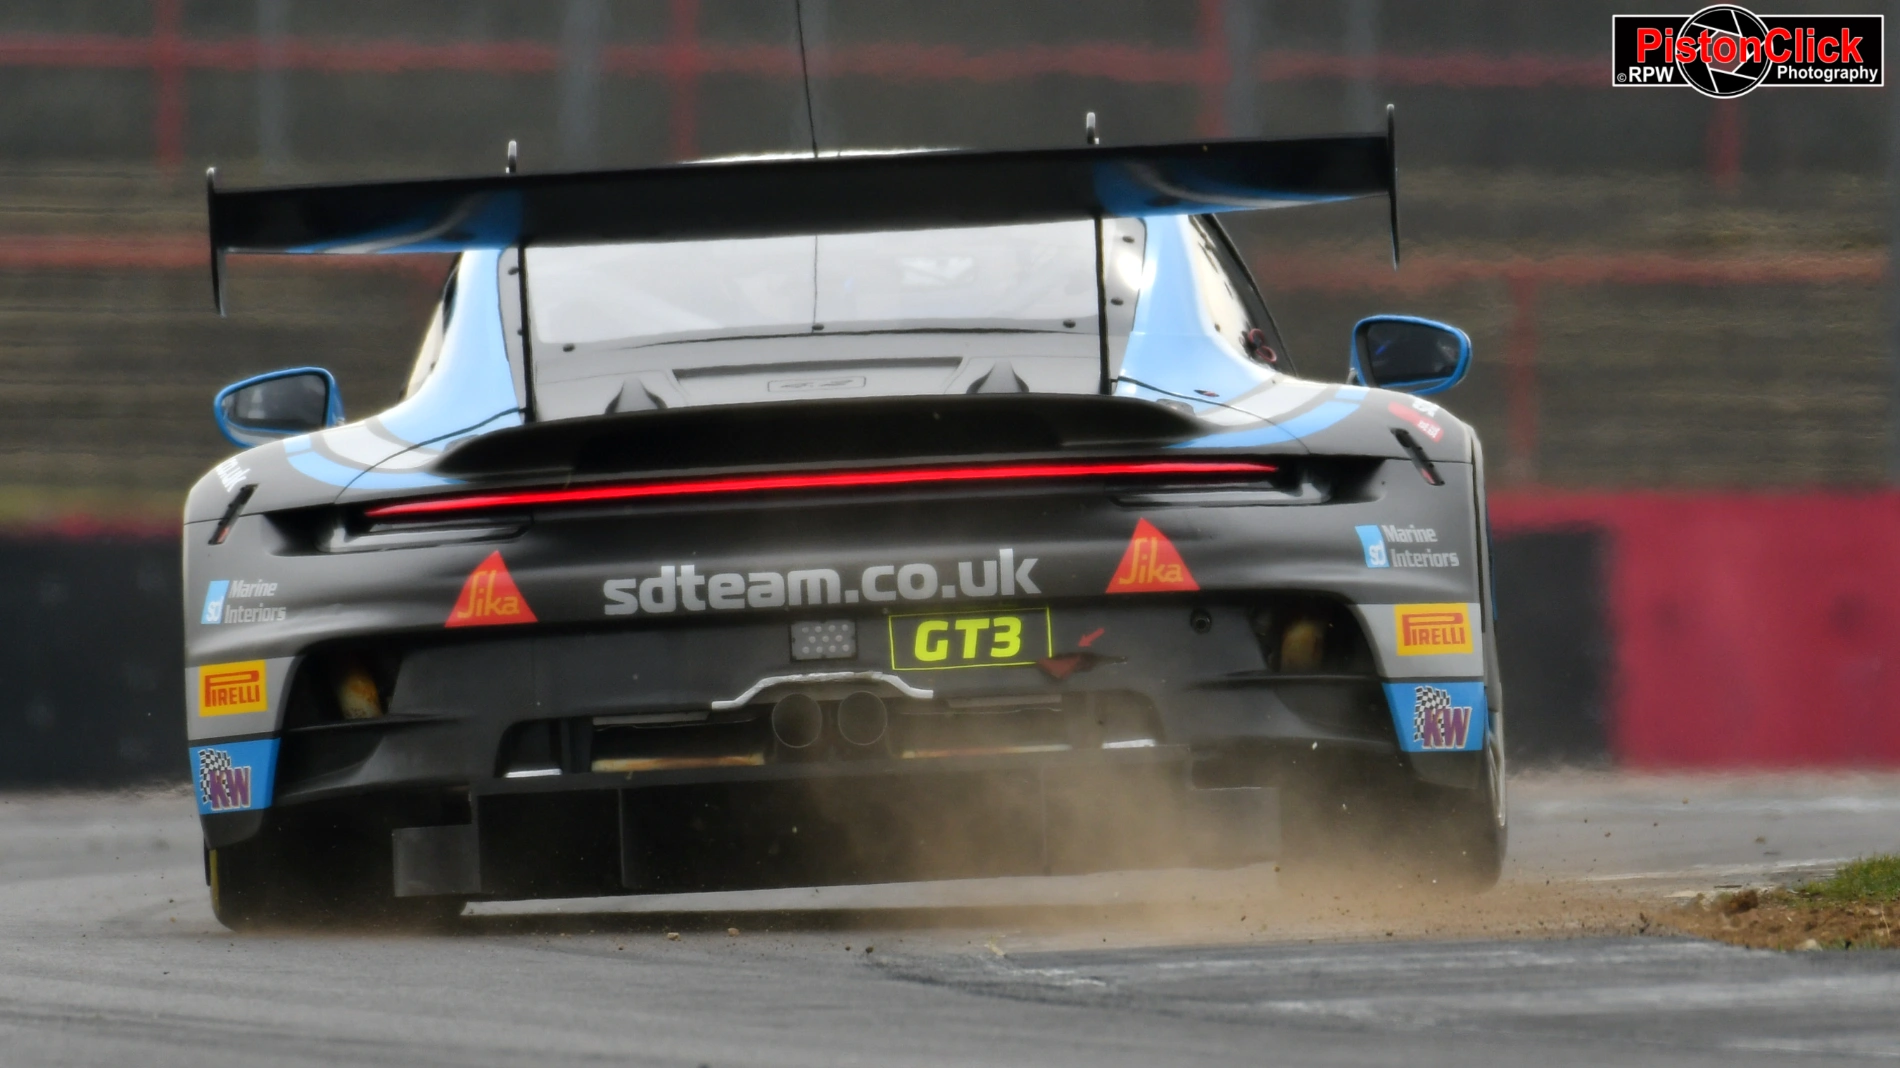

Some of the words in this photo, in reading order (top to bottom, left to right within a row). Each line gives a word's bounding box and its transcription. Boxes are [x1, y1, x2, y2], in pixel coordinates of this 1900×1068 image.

[1382, 524, 1438, 543] Marine
[1119, 536, 1184, 585] Sika
[1390, 548, 1460, 568] Interiors
[228, 579, 278, 598] Marine
[457, 569, 520, 618] Sika
[603, 548, 1042, 616] sdteam.co.uk
[224, 603, 286, 624] Interiors
[1402, 612, 1466, 646] PIRELLI
[913, 616, 1022, 662] GT3
[204, 670, 261, 708] PIRELLI
[1422, 706, 1472, 749] KW
[209, 766, 251, 811] KW
